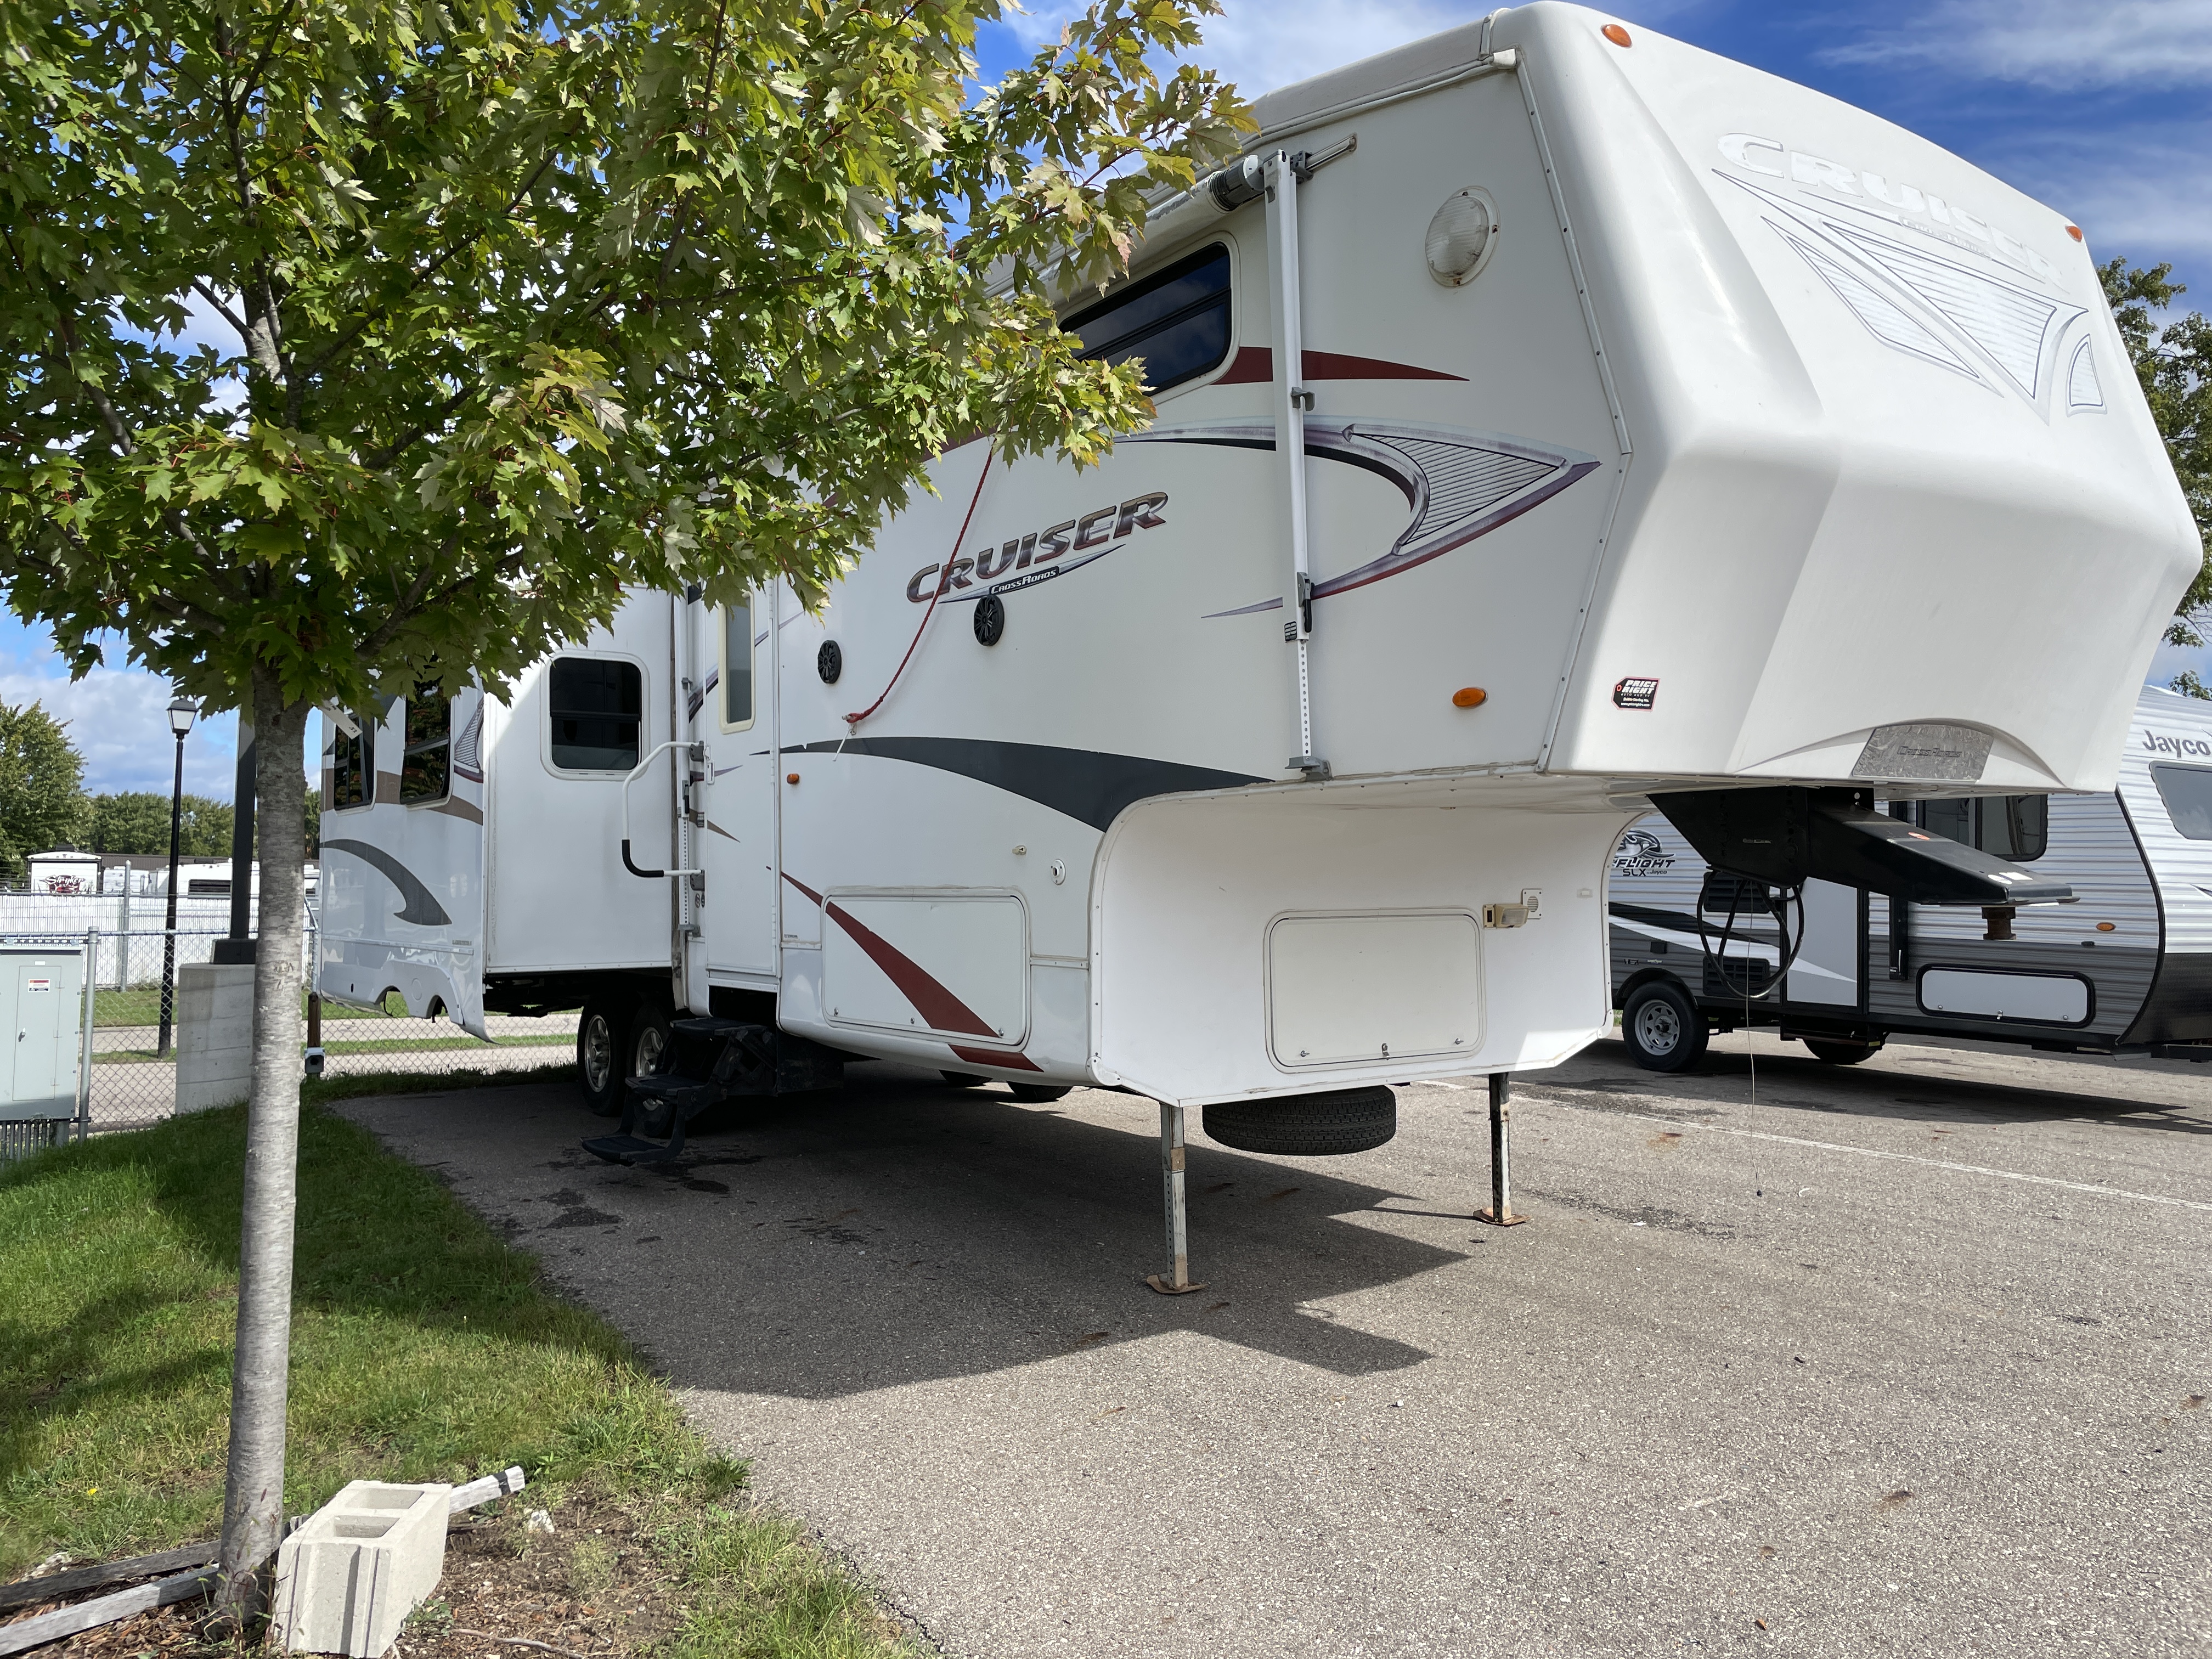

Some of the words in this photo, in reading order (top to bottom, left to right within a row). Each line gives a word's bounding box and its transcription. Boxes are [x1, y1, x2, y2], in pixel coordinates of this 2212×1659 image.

[1718, 133, 2070, 294] CRUISER
[906, 492, 1169, 602] CRUISER
[1625, 680, 1657, 688] PRICE
[2142, 729, 2211, 758] Jayco
[1616, 857, 1675, 868] FLIGHT
[1622, 868, 1646, 877] SLX
[45, 874, 86, 886] Stryker
